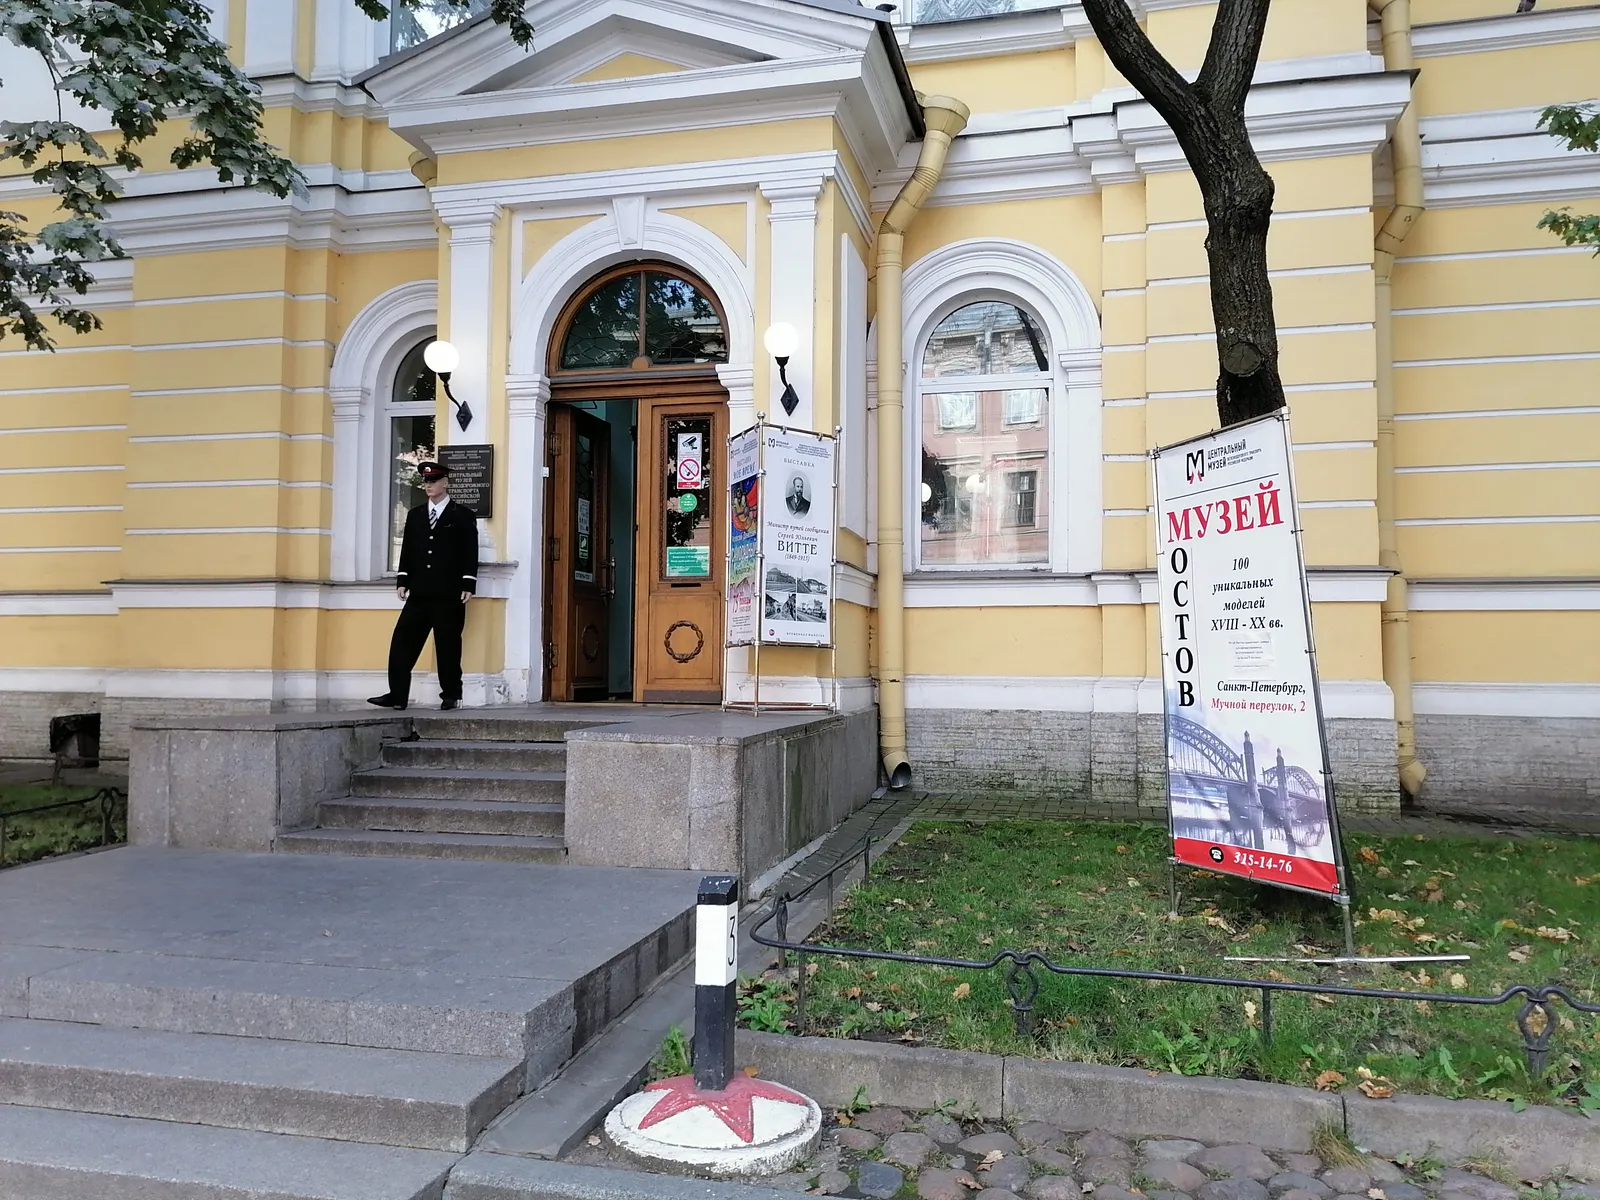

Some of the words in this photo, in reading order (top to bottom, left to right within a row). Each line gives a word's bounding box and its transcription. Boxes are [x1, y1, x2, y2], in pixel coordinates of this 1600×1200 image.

[1207, 439, 1246, 460] ЦЕНТРАЛЬНЫЙ
[783, 458, 815, 468] ВЫСТАВКА
[1207, 457, 1227, 472] МУЗЕЙ
[1166, 480, 1284, 543] МУЗЕЙ
[766, 520, 789, 531] Министр
[789, 524, 804, 532] путей
[804, 526, 830, 534] сообщения
[777, 532, 794, 540] Сергей
[795, 534, 818, 542] Юльевич
[777, 540, 818, 556] ВИТТЕ
[1232, 556, 1250, 571] 100
[1211, 576, 1274, 595] уникальных
[1223, 597, 1266, 611] моделей
[1211, 618, 1239, 632] XVIII
[1249, 616, 1267, 630] XX
[1269, 619, 1284, 629] вв.
[1217, 680, 1306, 696] Санкт-Петербург,
[1211, 698, 1247, 711] Мучной
[1250, 701, 1297, 713] переулок,
[1300, 701, 1306, 712] 2
[1233, 851, 1293, 874] 315-14-76
[728, 915, 735, 966] 3
